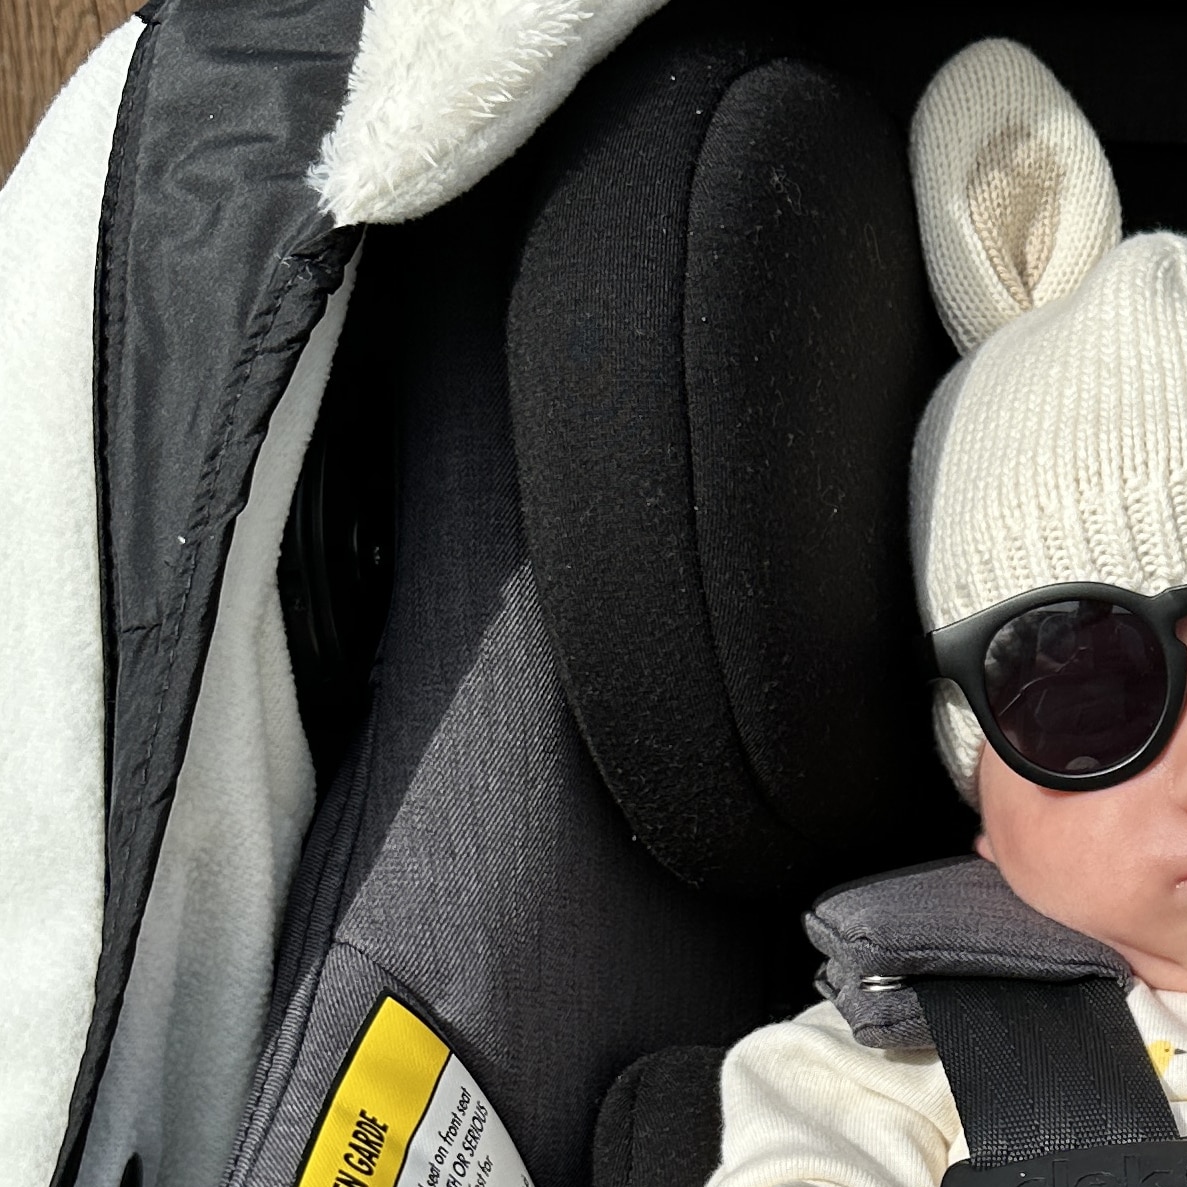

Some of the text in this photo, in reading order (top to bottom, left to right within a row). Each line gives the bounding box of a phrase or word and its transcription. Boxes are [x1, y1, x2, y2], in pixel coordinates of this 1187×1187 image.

[456, 1085, 472, 1117] seat
[343, 1109, 389, 1177] GARDE
[437, 1111, 463, 1147] front
[461, 1100, 489, 1158] SERIOUS
[433, 1145, 450, 1166] on
[452, 1152, 471, 1178] OR
[477, 1154, 494, 1178] for
